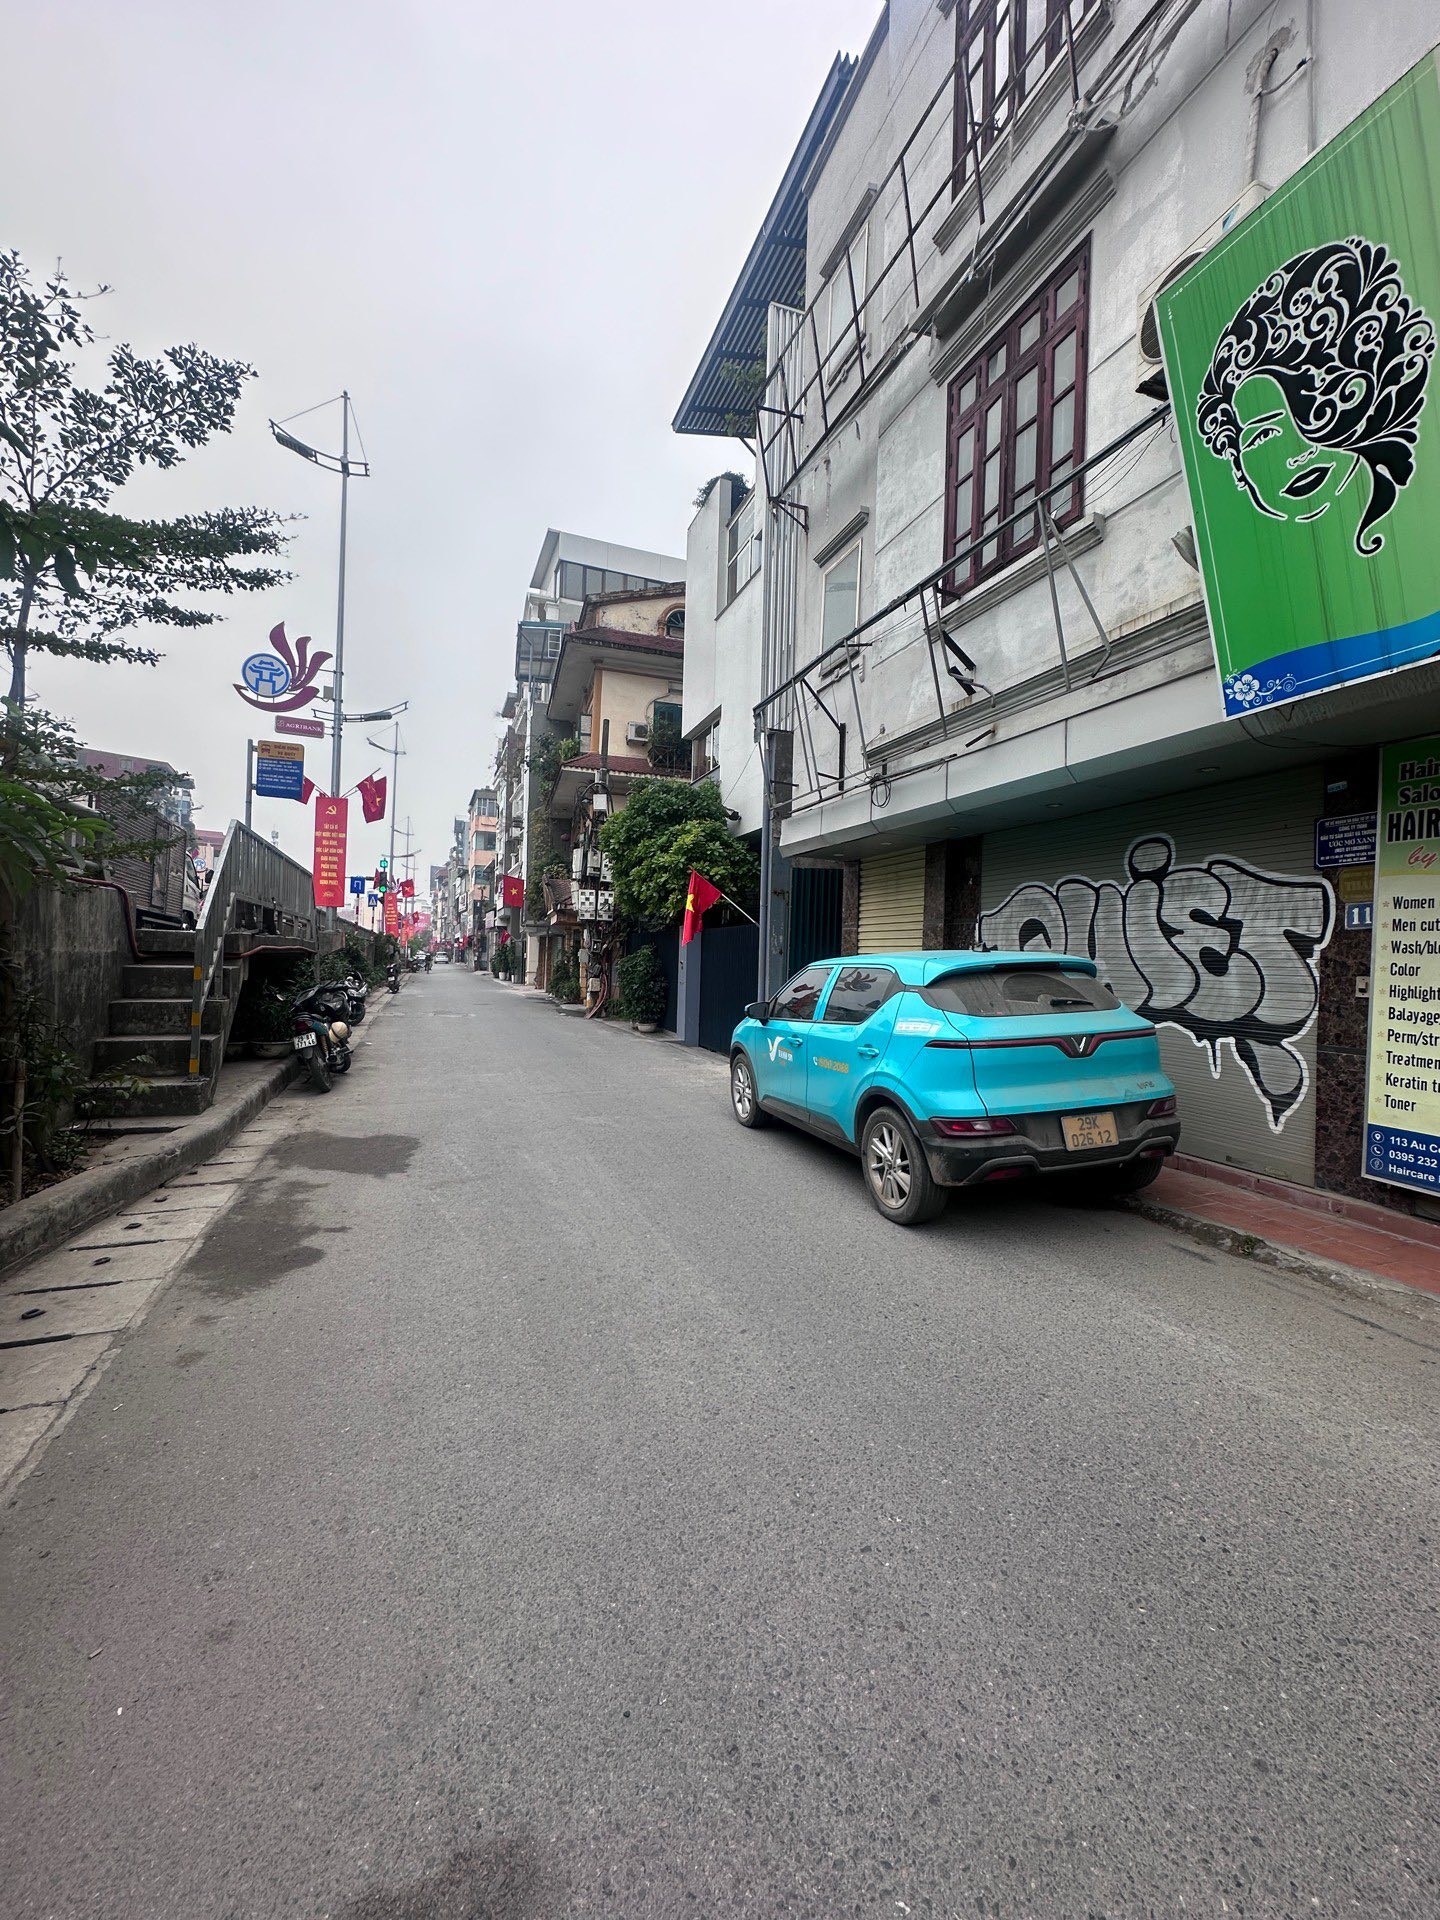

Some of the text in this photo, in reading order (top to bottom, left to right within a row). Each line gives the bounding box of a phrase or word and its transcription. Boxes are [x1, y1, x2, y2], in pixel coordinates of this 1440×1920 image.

[285, 723, 322, 732] AGRIBANK
[1387, 807, 1440, 843] HAIR
[1408, 846, 1438, 869] by
[1393, 896, 1435, 910] Women
[1392, 918, 1440, 932] Men cut
[1390, 962, 1421, 977] Color
[1387, 1028, 1440, 1046] Perm/str
[1386, 1050, 1440, 1070] Treatmen
[1386, 1072, 1427, 1092] Keratin
[1384, 1094, 1416, 1112] Toner
[1077, 1116, 1100, 1131] 29K
[1072, 1130, 1112, 1147] 026.12
[1390, 1136, 1408, 1147] 113
[1410, 1140, 1426, 1151] Au
[1389, 1150, 1437, 1168] 0395 232
[1389, 1164, 1435, 1182] Haircare
